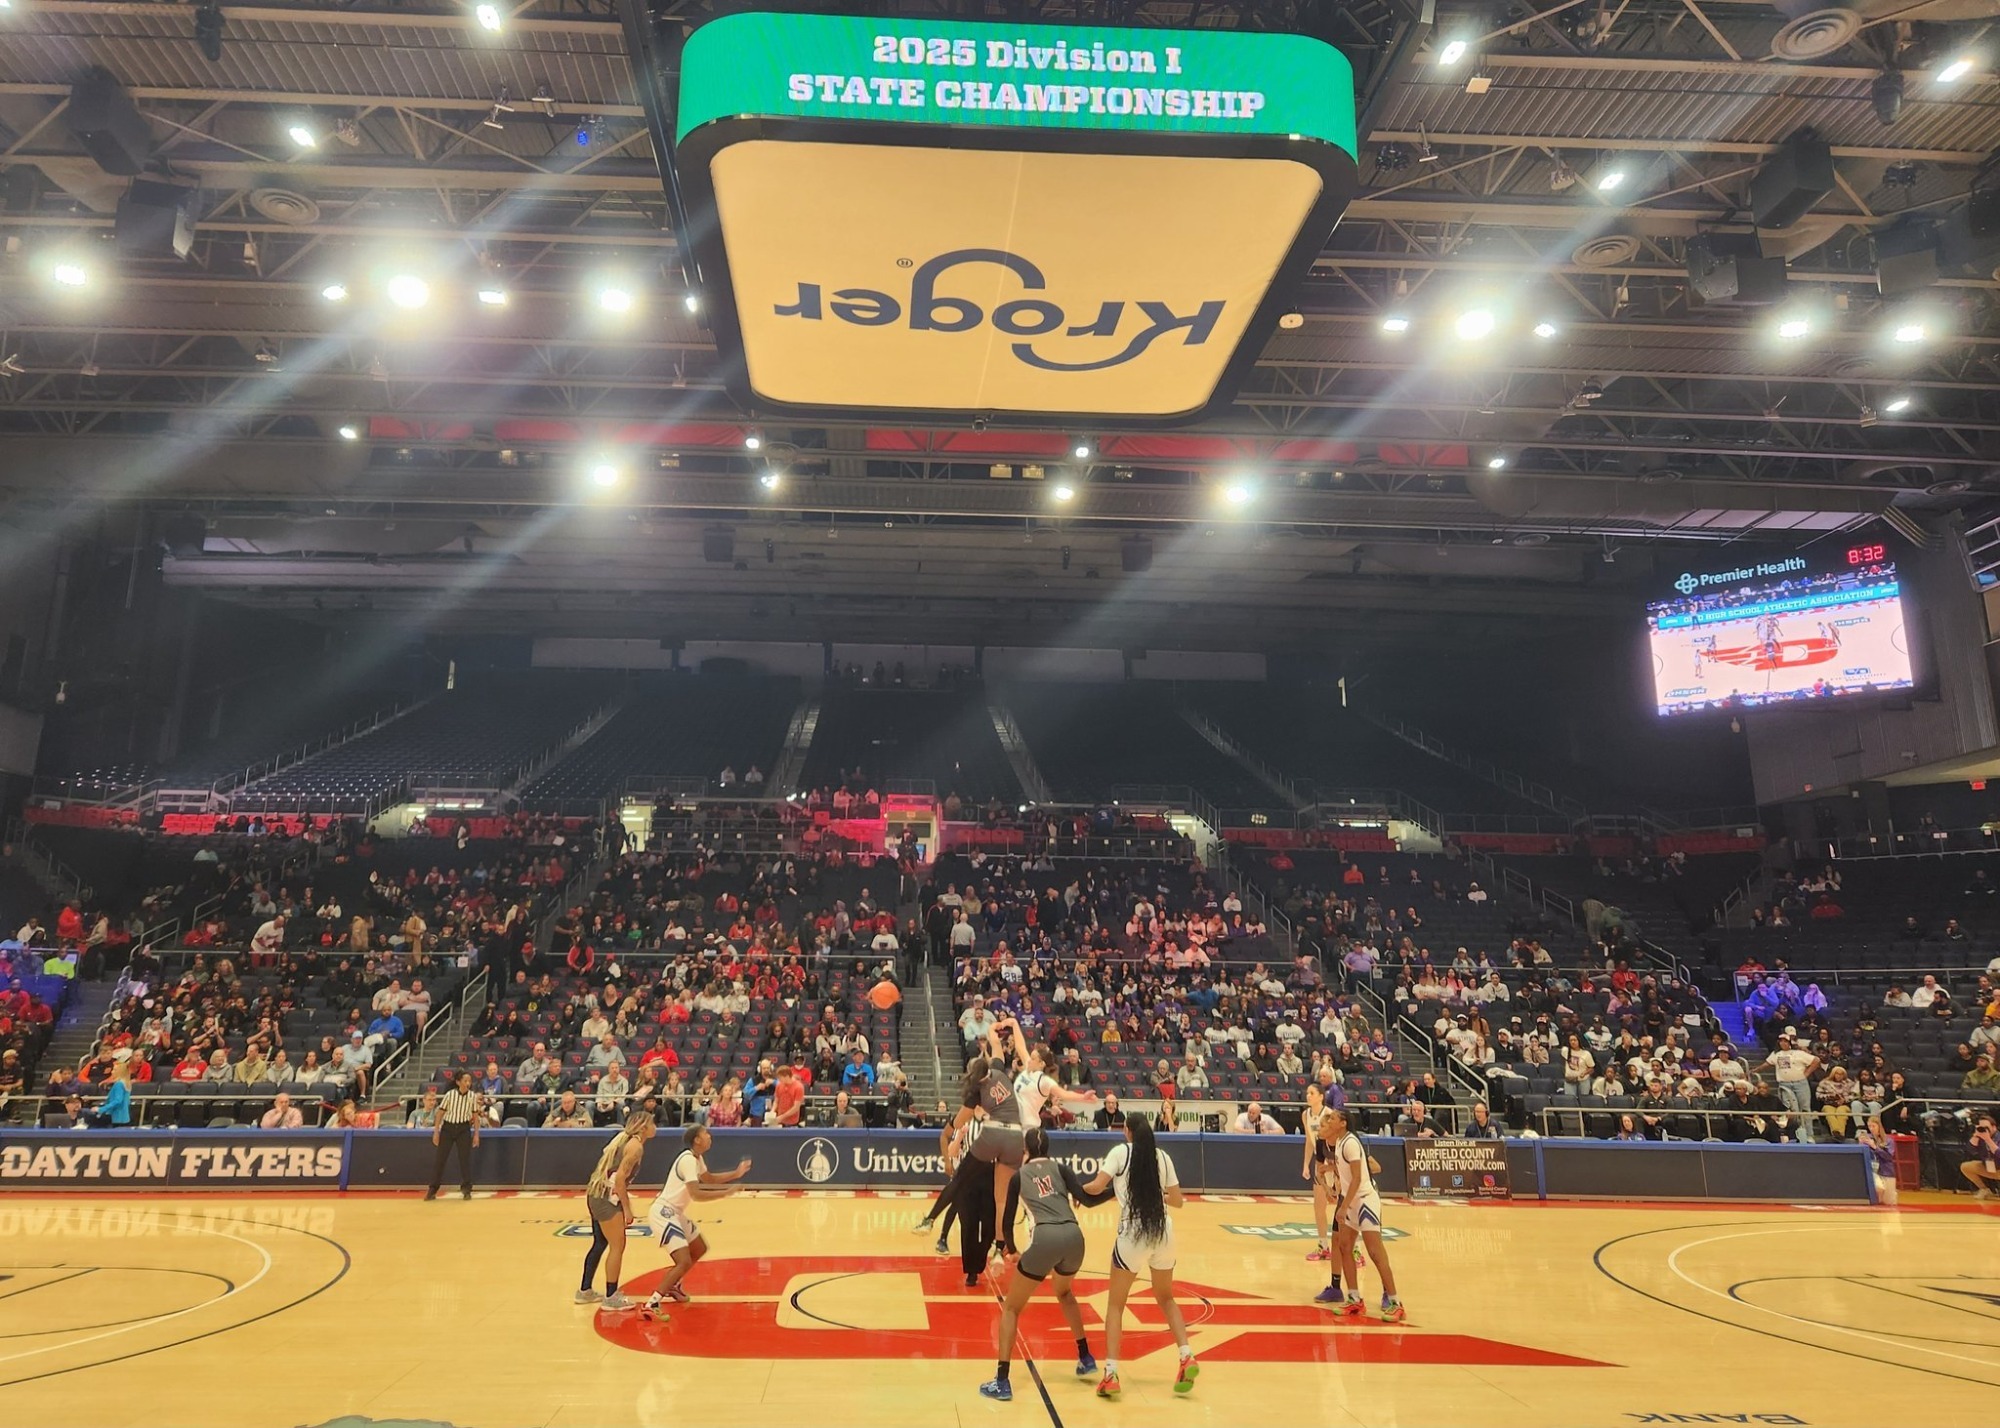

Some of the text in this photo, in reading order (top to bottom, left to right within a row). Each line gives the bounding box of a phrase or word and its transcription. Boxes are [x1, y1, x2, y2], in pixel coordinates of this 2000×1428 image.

[873, 36, 1182, 75] 2025 Division I
[788, 74, 1265, 119] STATE CHAMPIONSHIP
[774, 248, 1226, 372] Kroger
[1848, 545, 1884, 564] 8:32
[1700, 556, 1806, 586] Premier Health
[1728, 606, 1761, 618] SCHOOL
[1764, 600, 1808, 613] ATHLETIC
[1810, 590, 1874, 605] ASSOCIATION
[989, 1080, 1012, 1105] 21
[0, 1145, 343, 1178] DAYTON FLYERS
[1408, 1160, 1506, 1171] SPORTS NETWORK.com
[1415, 1148, 1495, 1160] FAIRFIELD COUNTY
[1032, 1174, 1055, 1198] 11
[1622, 1412, 1814, 1425] BANK
